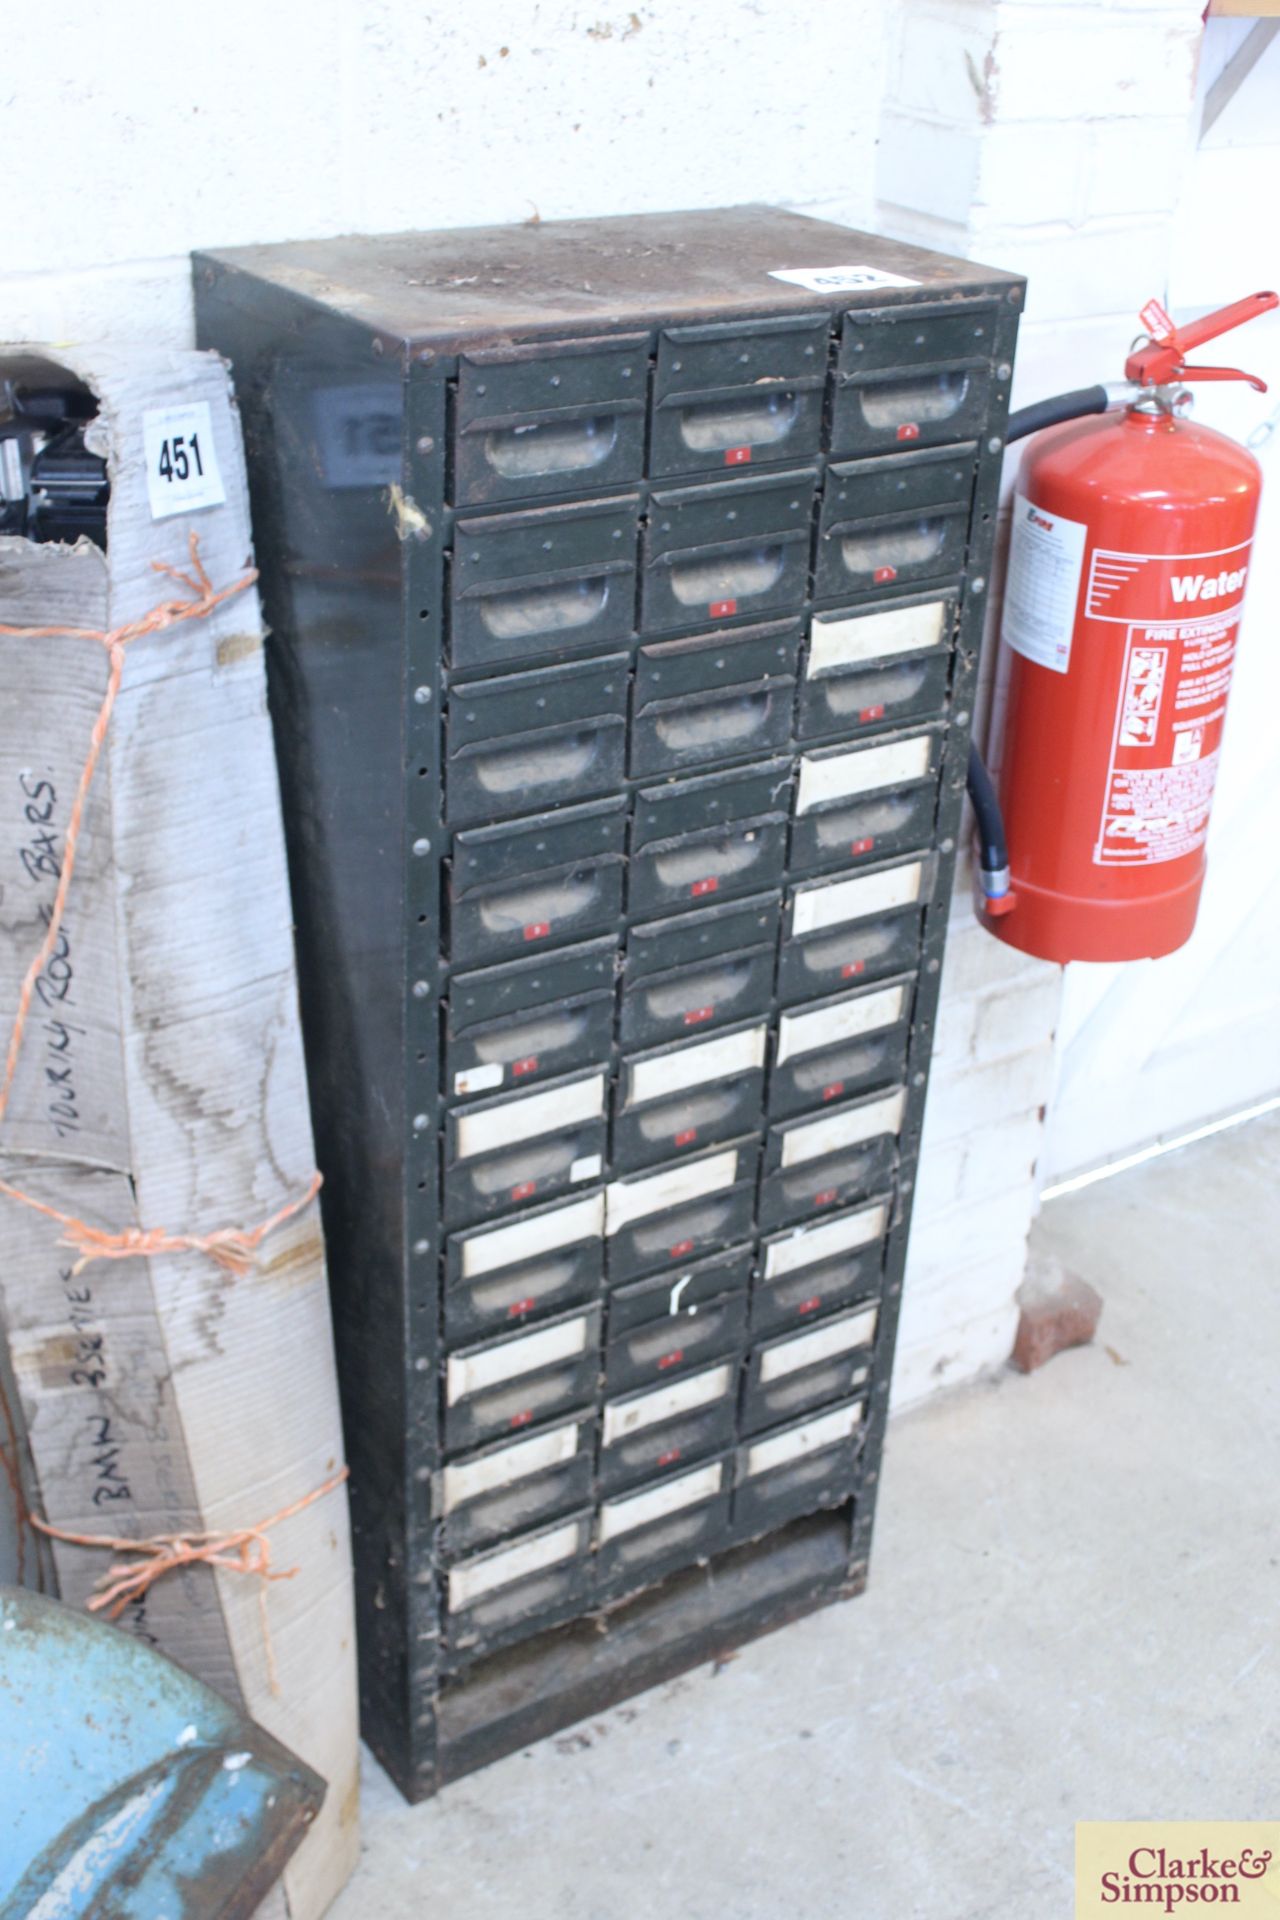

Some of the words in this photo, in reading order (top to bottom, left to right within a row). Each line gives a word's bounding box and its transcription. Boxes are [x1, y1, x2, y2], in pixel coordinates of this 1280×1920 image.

[158, 433, 204, 483] 451
[1170, 566, 1247, 604] Water
[86, 1415, 132, 1505] BMW
